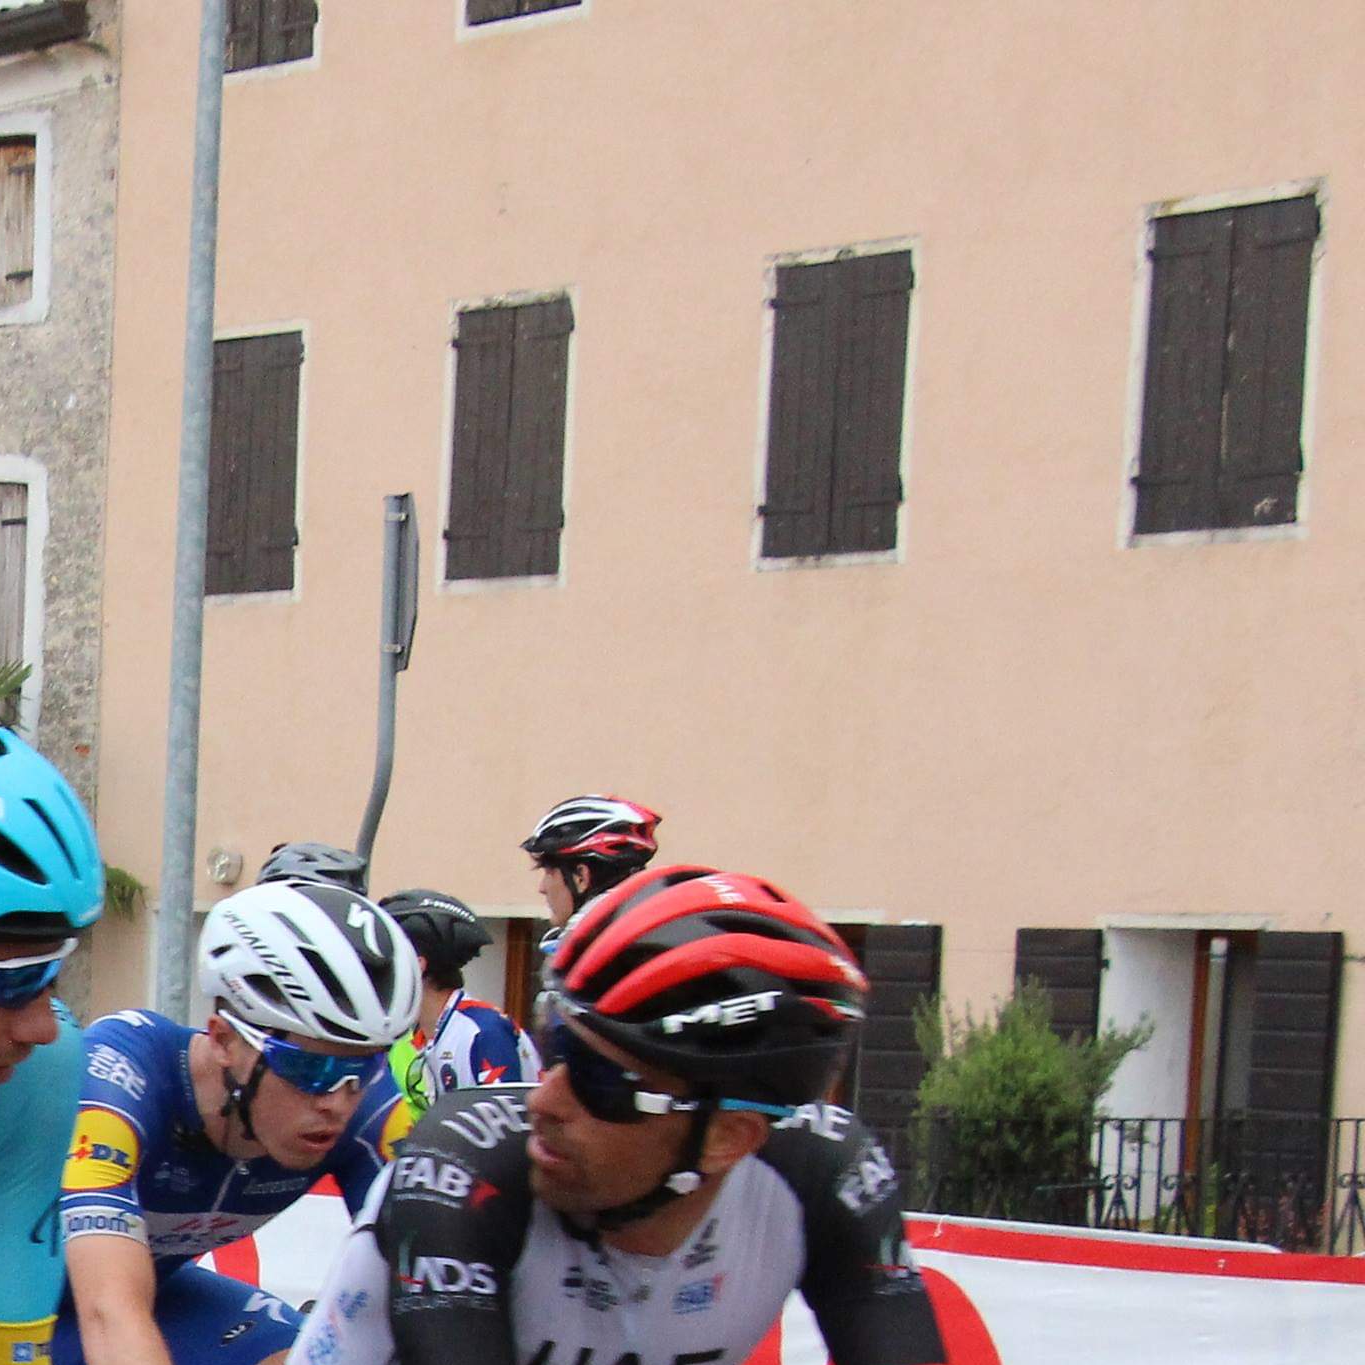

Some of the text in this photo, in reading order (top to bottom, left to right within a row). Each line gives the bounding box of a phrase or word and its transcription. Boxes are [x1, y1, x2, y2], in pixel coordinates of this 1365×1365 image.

[661, 990, 783, 1035] MET
[441, 1094, 535, 1150] UAE
[393, 1155, 474, 1198] FAB
